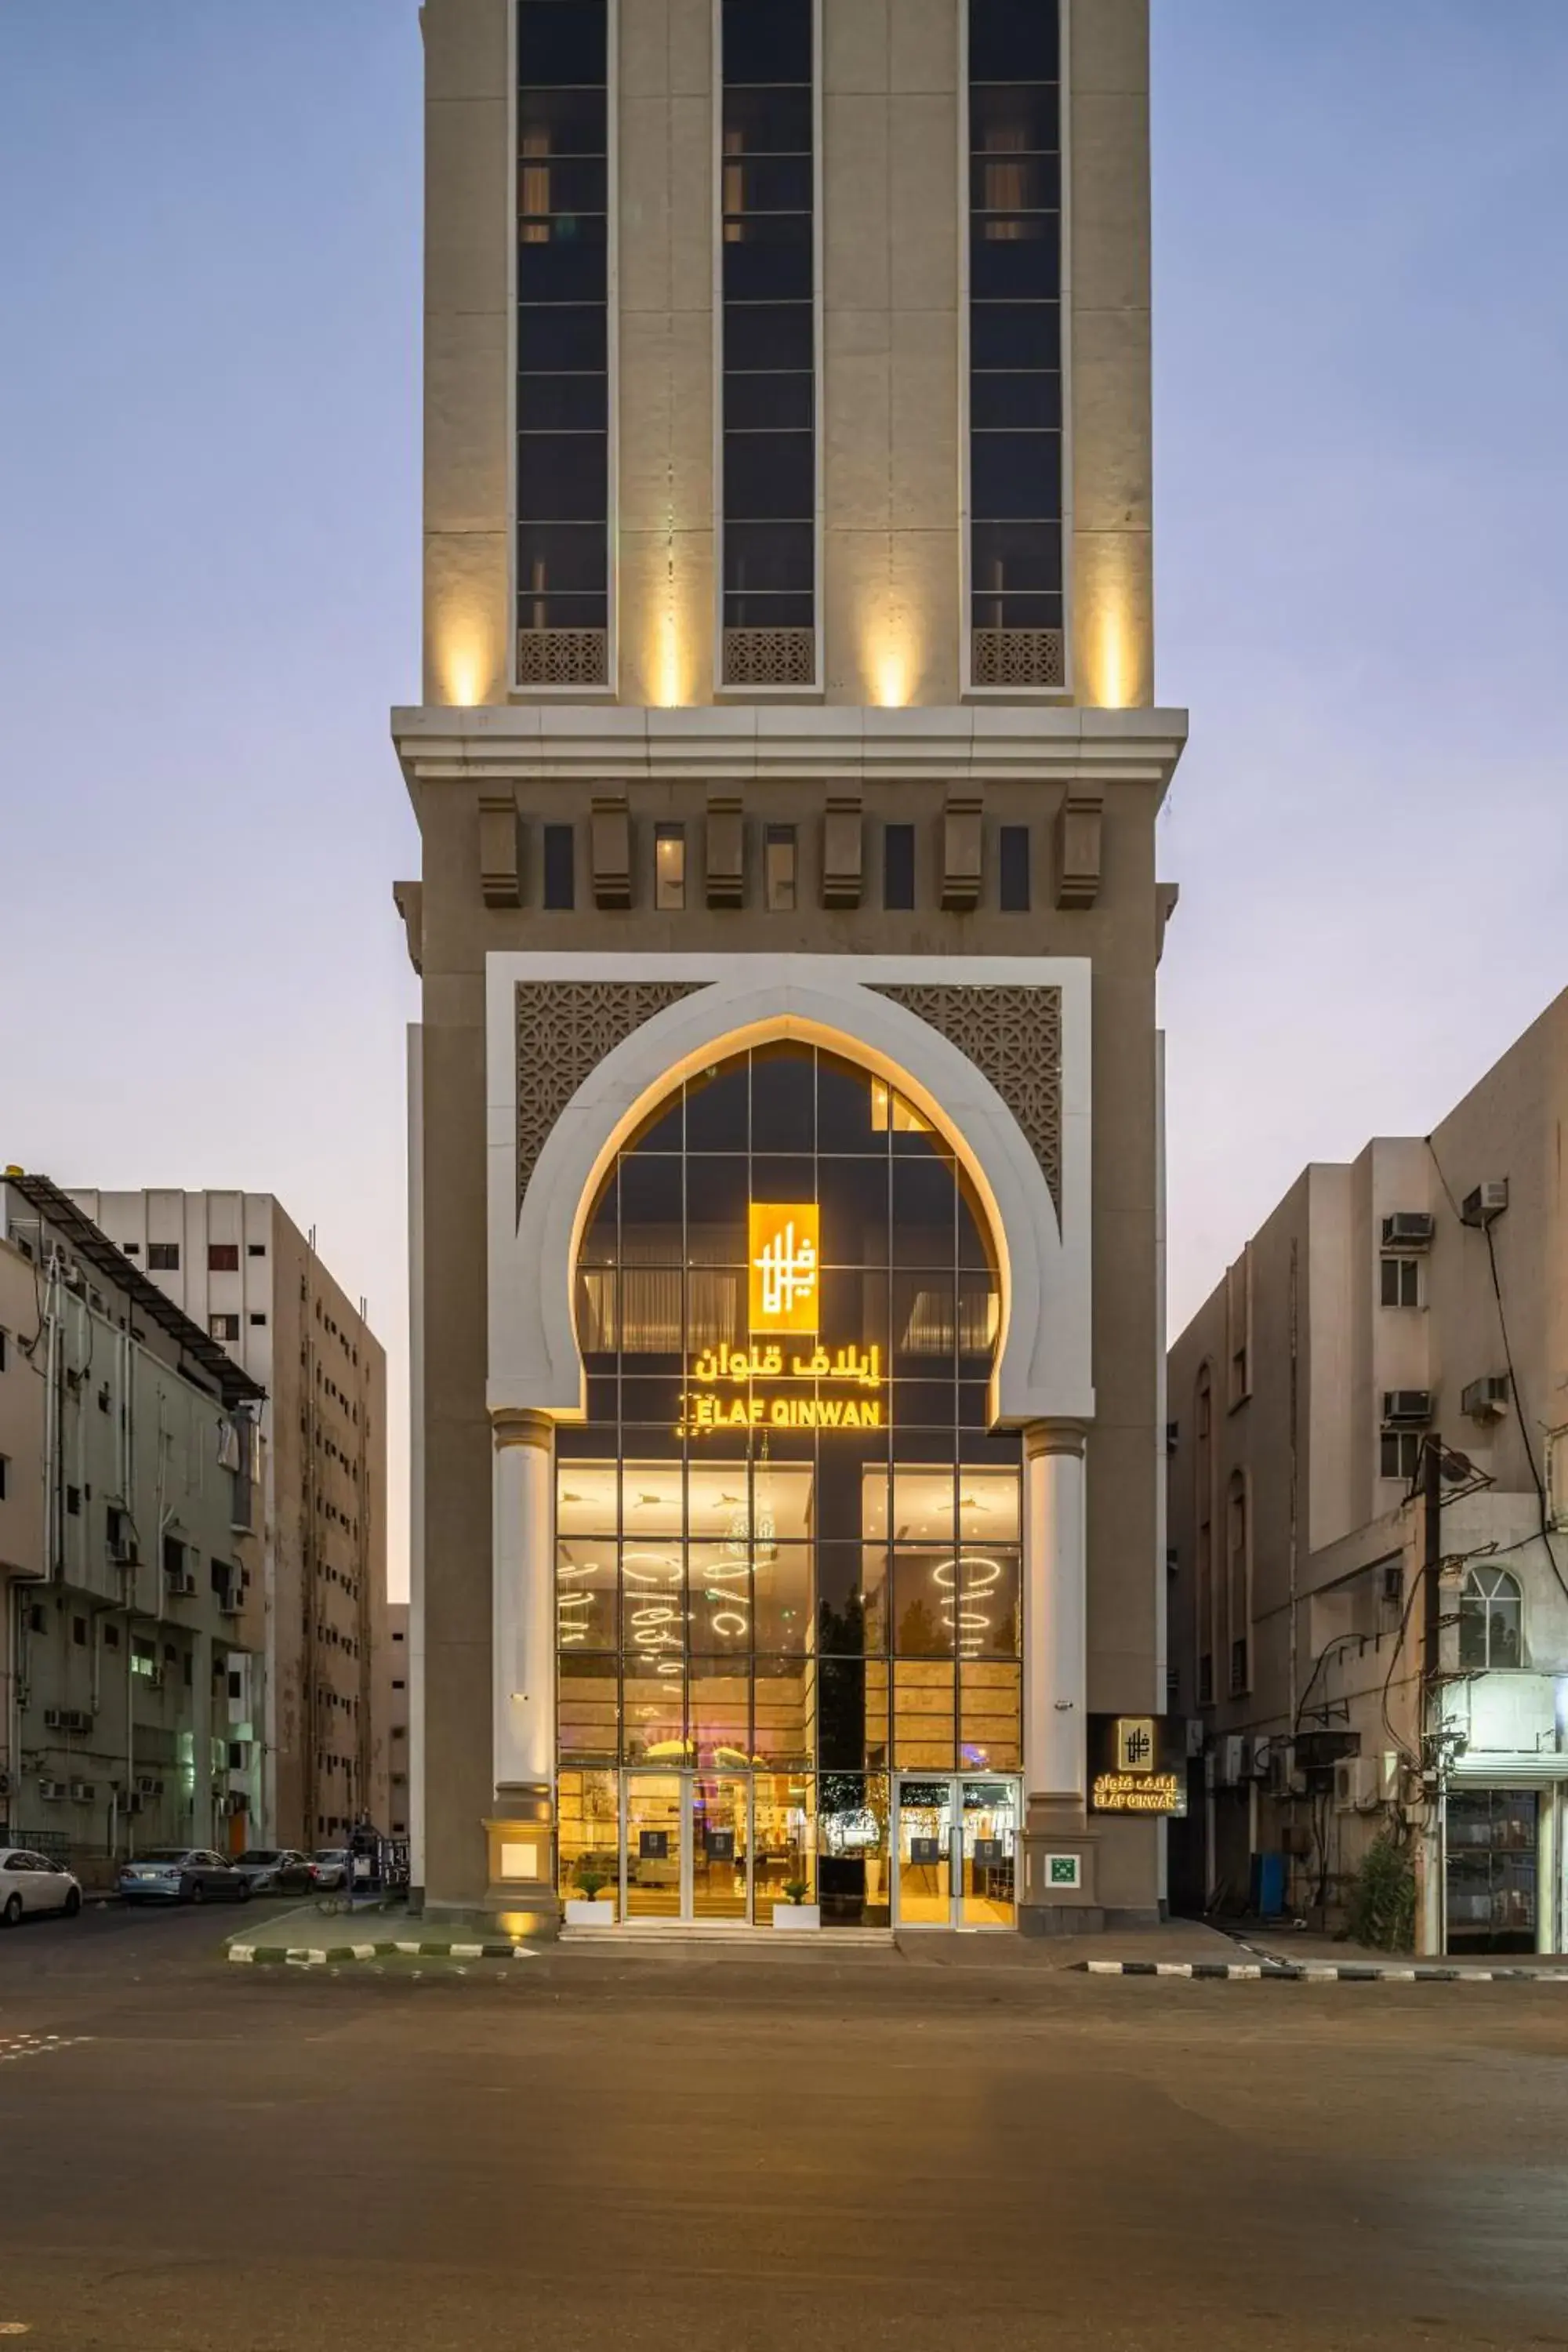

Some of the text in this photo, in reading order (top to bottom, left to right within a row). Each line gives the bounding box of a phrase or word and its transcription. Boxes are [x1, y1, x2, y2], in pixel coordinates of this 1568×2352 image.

[695, 1343, 880, 1387] إيلاف قنوان
[696, 1399, 880, 1426] ELAF QINWAN
